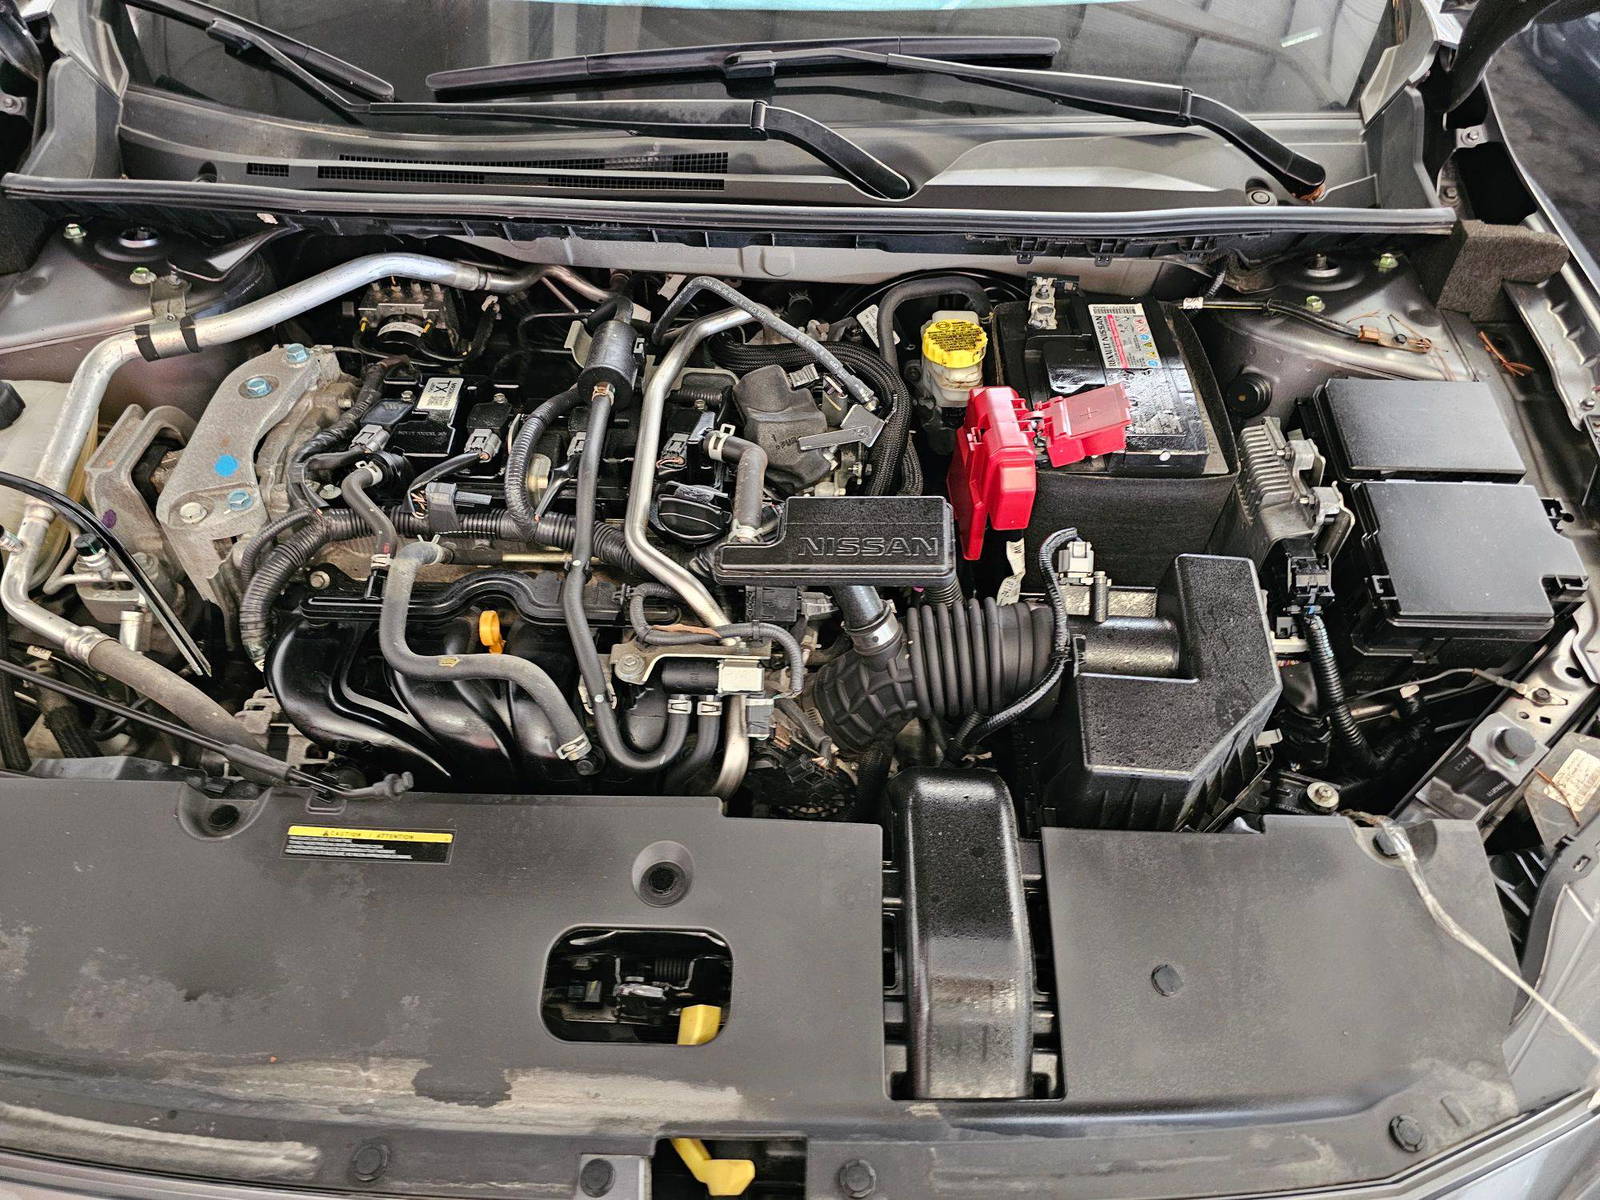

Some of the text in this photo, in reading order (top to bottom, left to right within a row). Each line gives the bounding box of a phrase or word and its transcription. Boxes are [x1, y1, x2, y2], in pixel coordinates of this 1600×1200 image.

[1095, 315, 1108, 341] NISSAN
[1103, 342, 1117, 367] RENAULT
[798, 537, 939, 557] NISSAN
